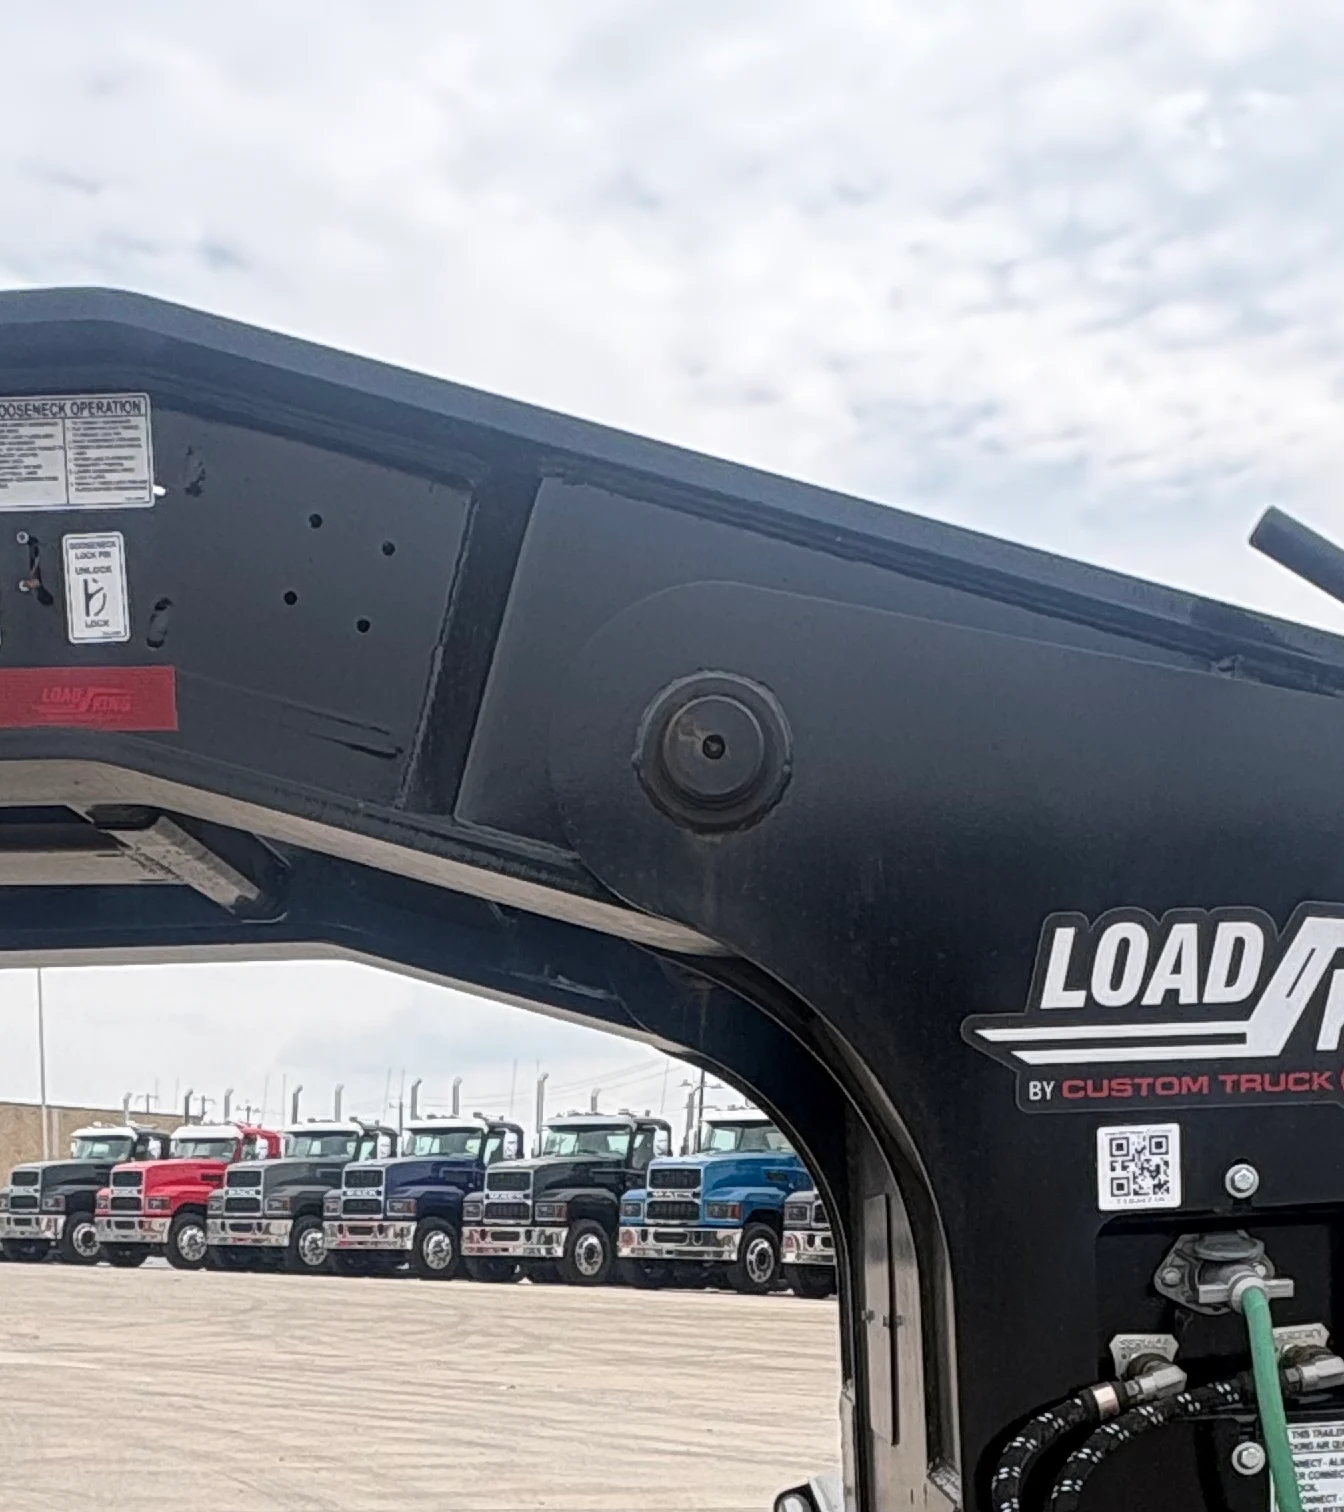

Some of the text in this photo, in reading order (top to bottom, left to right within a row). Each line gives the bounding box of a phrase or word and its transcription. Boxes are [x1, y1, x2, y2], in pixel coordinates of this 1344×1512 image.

[71, 401, 141, 415] OPERATION
[75, 566, 112, 575] UNLOCK
[85, 620, 109, 628] LOCK
[1040, 922, 1262, 1009] LOAD
[1029, 1081, 1054, 1100] BY
[1062, 1074, 1209, 1100] CUSTOM
[1220, 1070, 1332, 1094] TRUCK
[1292, 1430, 1309, 1439] THIS
